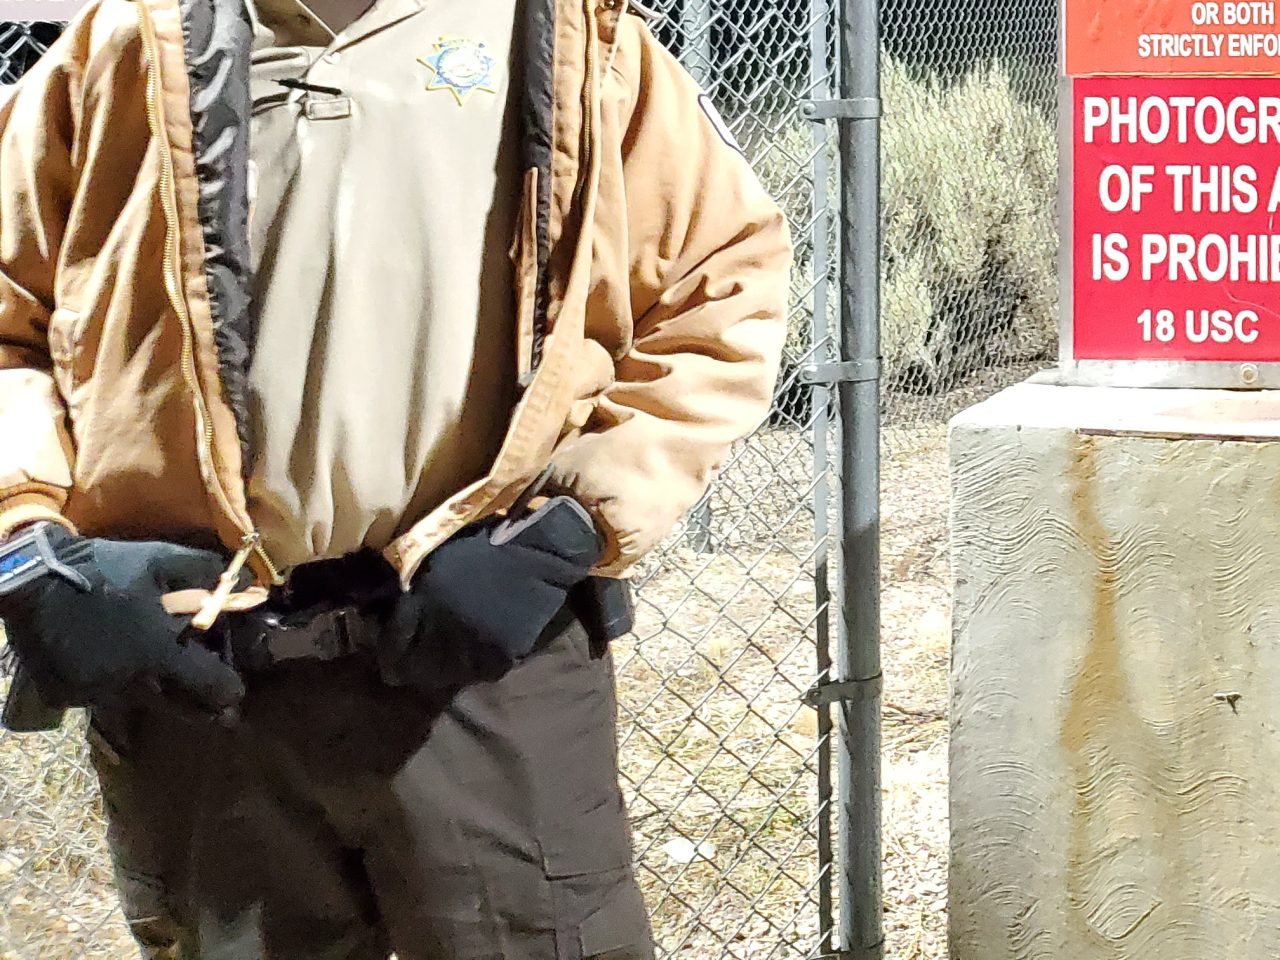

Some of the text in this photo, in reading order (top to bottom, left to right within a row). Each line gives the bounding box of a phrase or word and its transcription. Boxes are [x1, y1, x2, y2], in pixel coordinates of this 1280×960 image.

[1192, 2, 1274, 24] OR BOTH
[1139, 34, 1224, 57] STRICTLY
[1100, 165, 1154, 211] OF
[1166, 166, 1257, 212] THIS
[1093, 233, 1129, 280] IS
[1138, 310, 1174, 341] 18
[1186, 310, 1258, 342] USC
